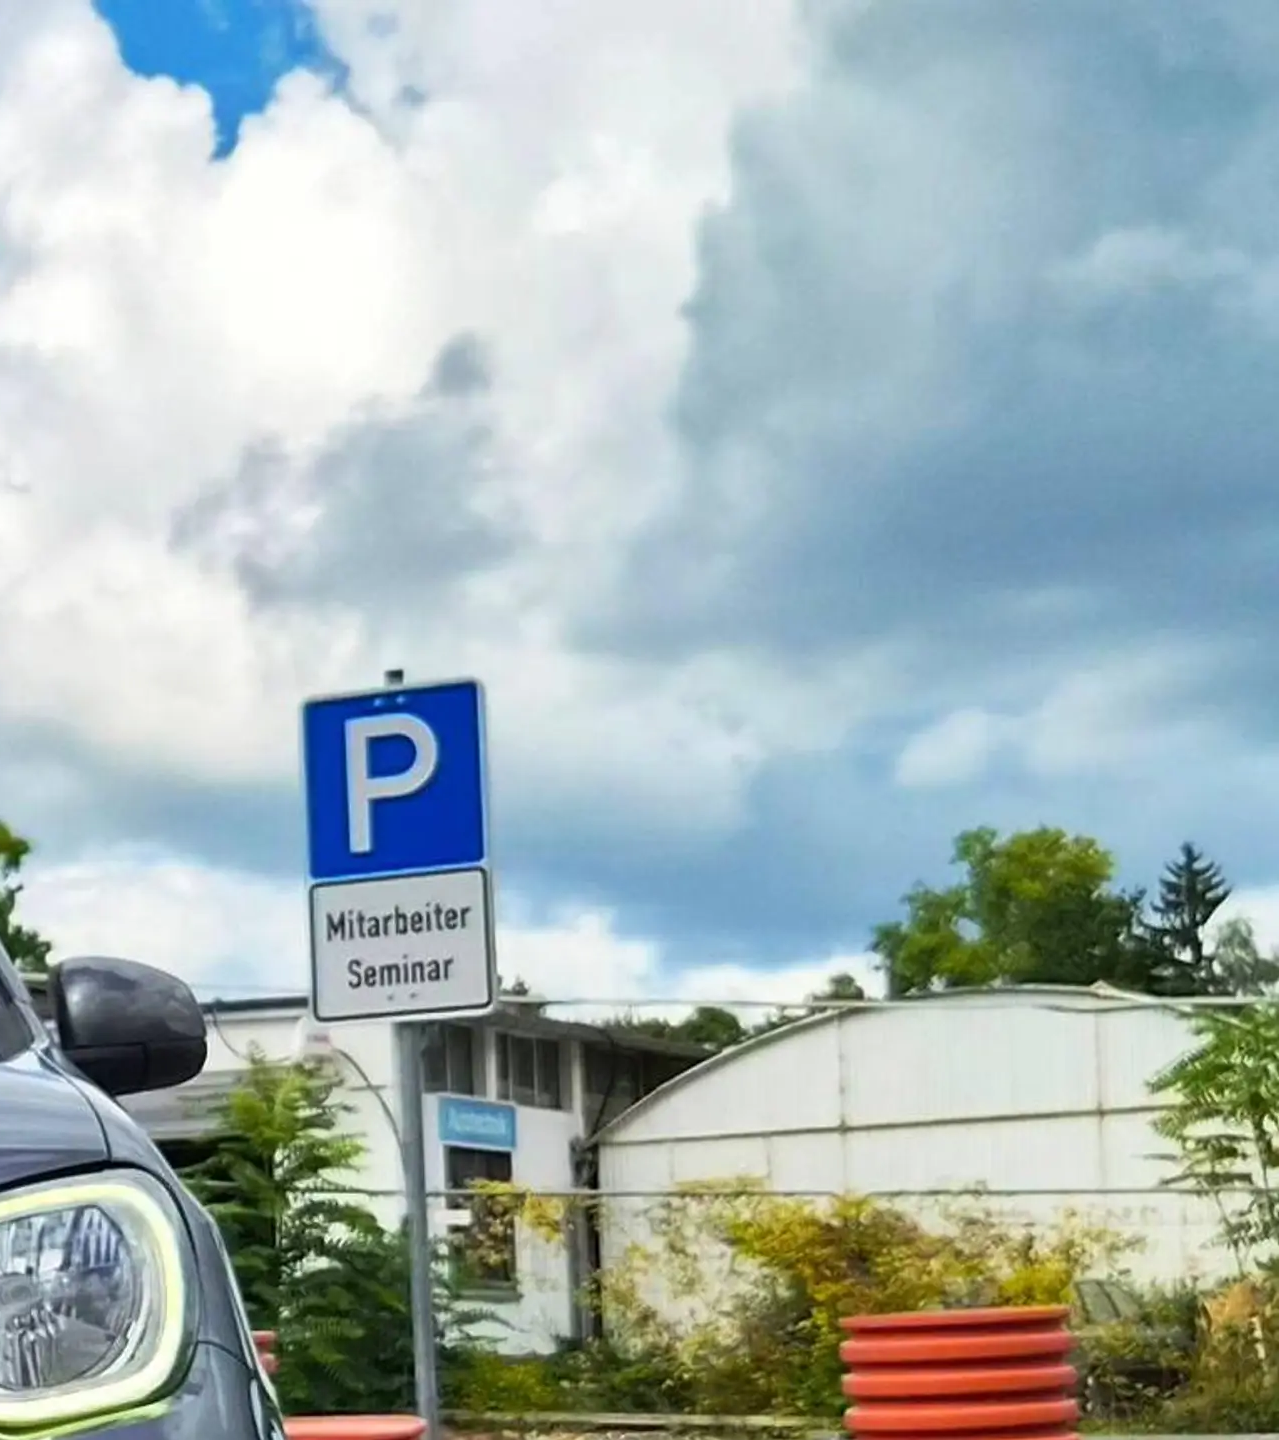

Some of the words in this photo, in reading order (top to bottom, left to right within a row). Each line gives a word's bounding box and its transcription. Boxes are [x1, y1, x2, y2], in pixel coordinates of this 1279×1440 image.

[343, 712, 439, 854] P
[325, 901, 472, 942] Mitarbeiter
[346, 954, 455, 990] Seminar
